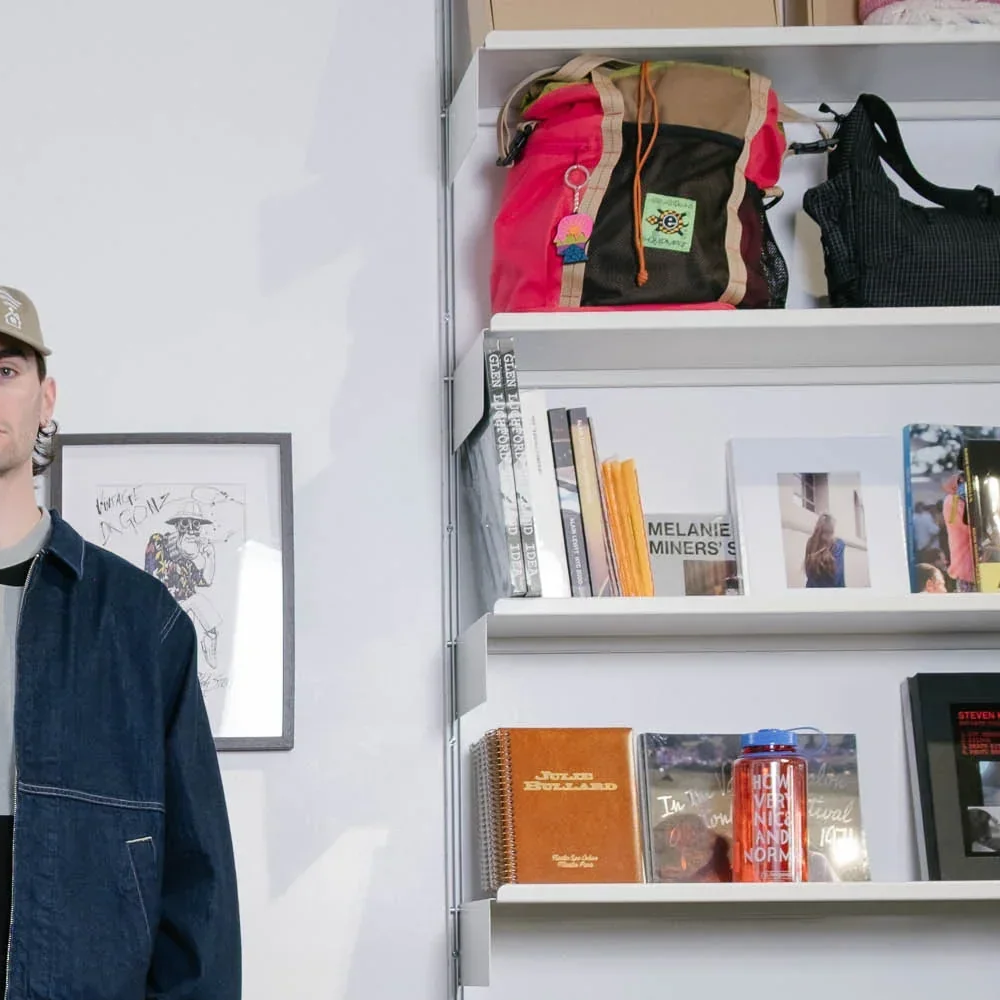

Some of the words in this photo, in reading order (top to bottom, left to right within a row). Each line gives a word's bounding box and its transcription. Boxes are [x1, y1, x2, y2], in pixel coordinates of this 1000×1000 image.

[489, 353, 502, 388] GLEN
[503, 353, 517, 388] GLEN
[648, 522, 731, 537] MELANIE
[649, 540, 722, 556] MINERS'
[525, 543, 538, 577] IDEA
[958, 711, 995, 720] STEVEN
[753, 773, 790, 790] HOW
[756, 829, 791, 845] AND
